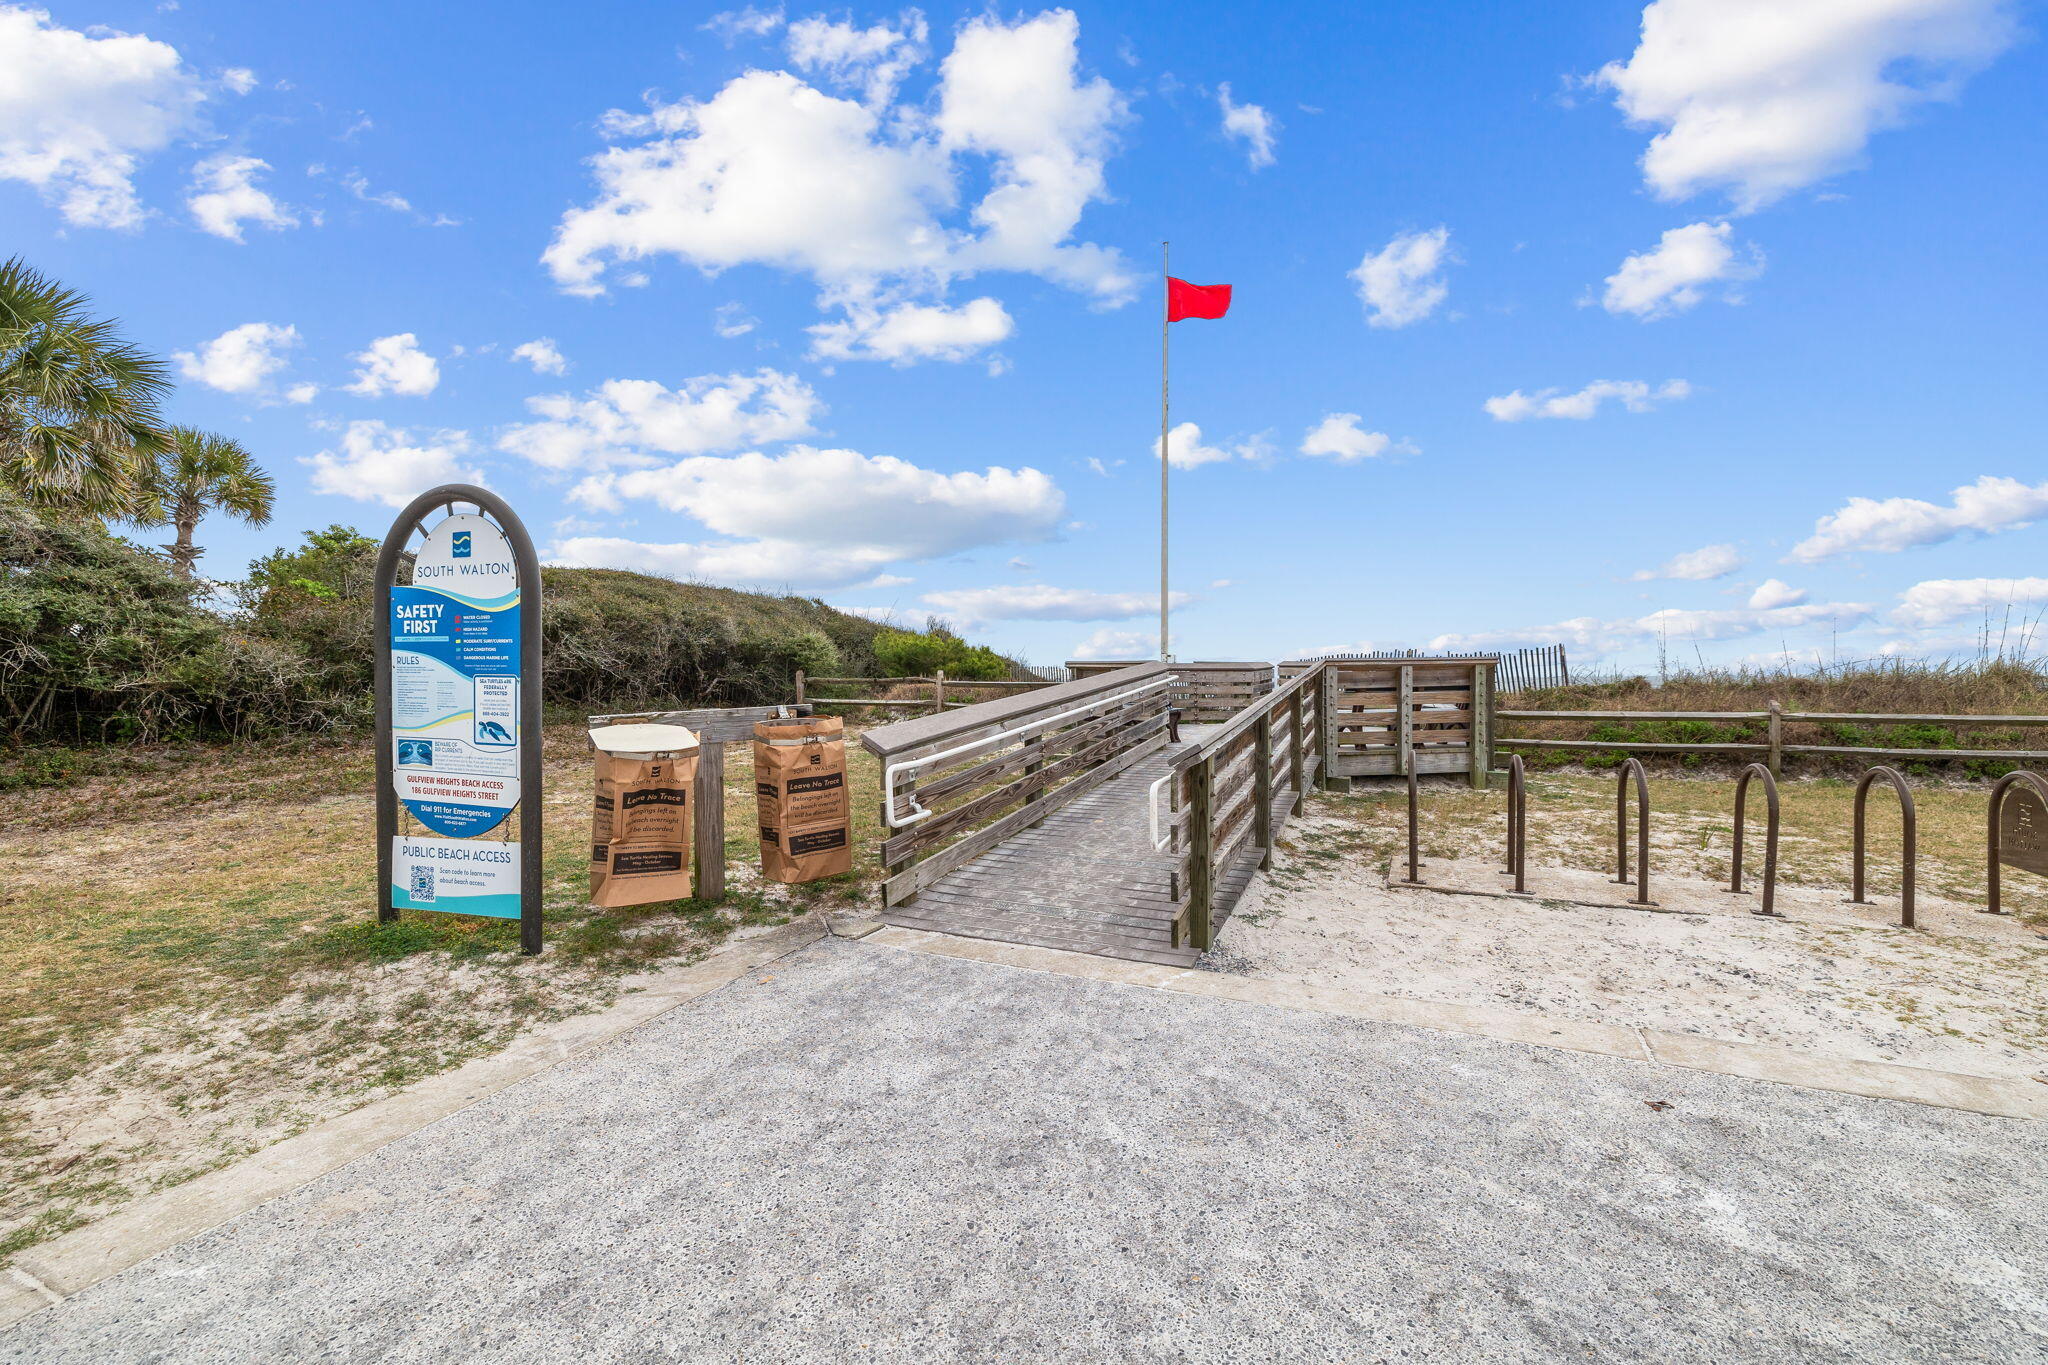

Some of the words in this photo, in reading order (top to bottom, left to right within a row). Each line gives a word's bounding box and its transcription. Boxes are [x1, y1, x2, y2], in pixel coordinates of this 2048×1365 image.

[418, 566, 454, 578] SOUTH
[460, 563, 510, 576] WALTON
[396, 605, 444, 618] SAFETY
[404, 620, 438, 633] FIRST
[397, 656, 420, 665] RULES
[407, 776, 435, 784] GULFVIEW
[437, 778, 460, 786] HEIGHTS
[462, 779, 480, 787] BEACH
[482, 781, 504, 789] ACCESS
[632, 779, 651, 787] SOUTH
[422, 787, 451, 796] GULFVIEW
[453, 790, 476, 798] HEIGHTS
[478, 792, 499, 800] STREET
[627, 796, 645, 804] Leave
[660, 793, 681, 802] Trace
[818, 799, 841, 807] overnight
[444, 806, 452, 814] for
[453, 808, 491, 818] Emergencies
[402, 846, 436, 858] PUBLIC
[438, 848, 470, 860] BEACH
[472, 850, 511, 863] ACCESS
[440, 867, 451, 875] Scan
[452, 868, 463, 876] code
[454, 878, 468, 886] beach
